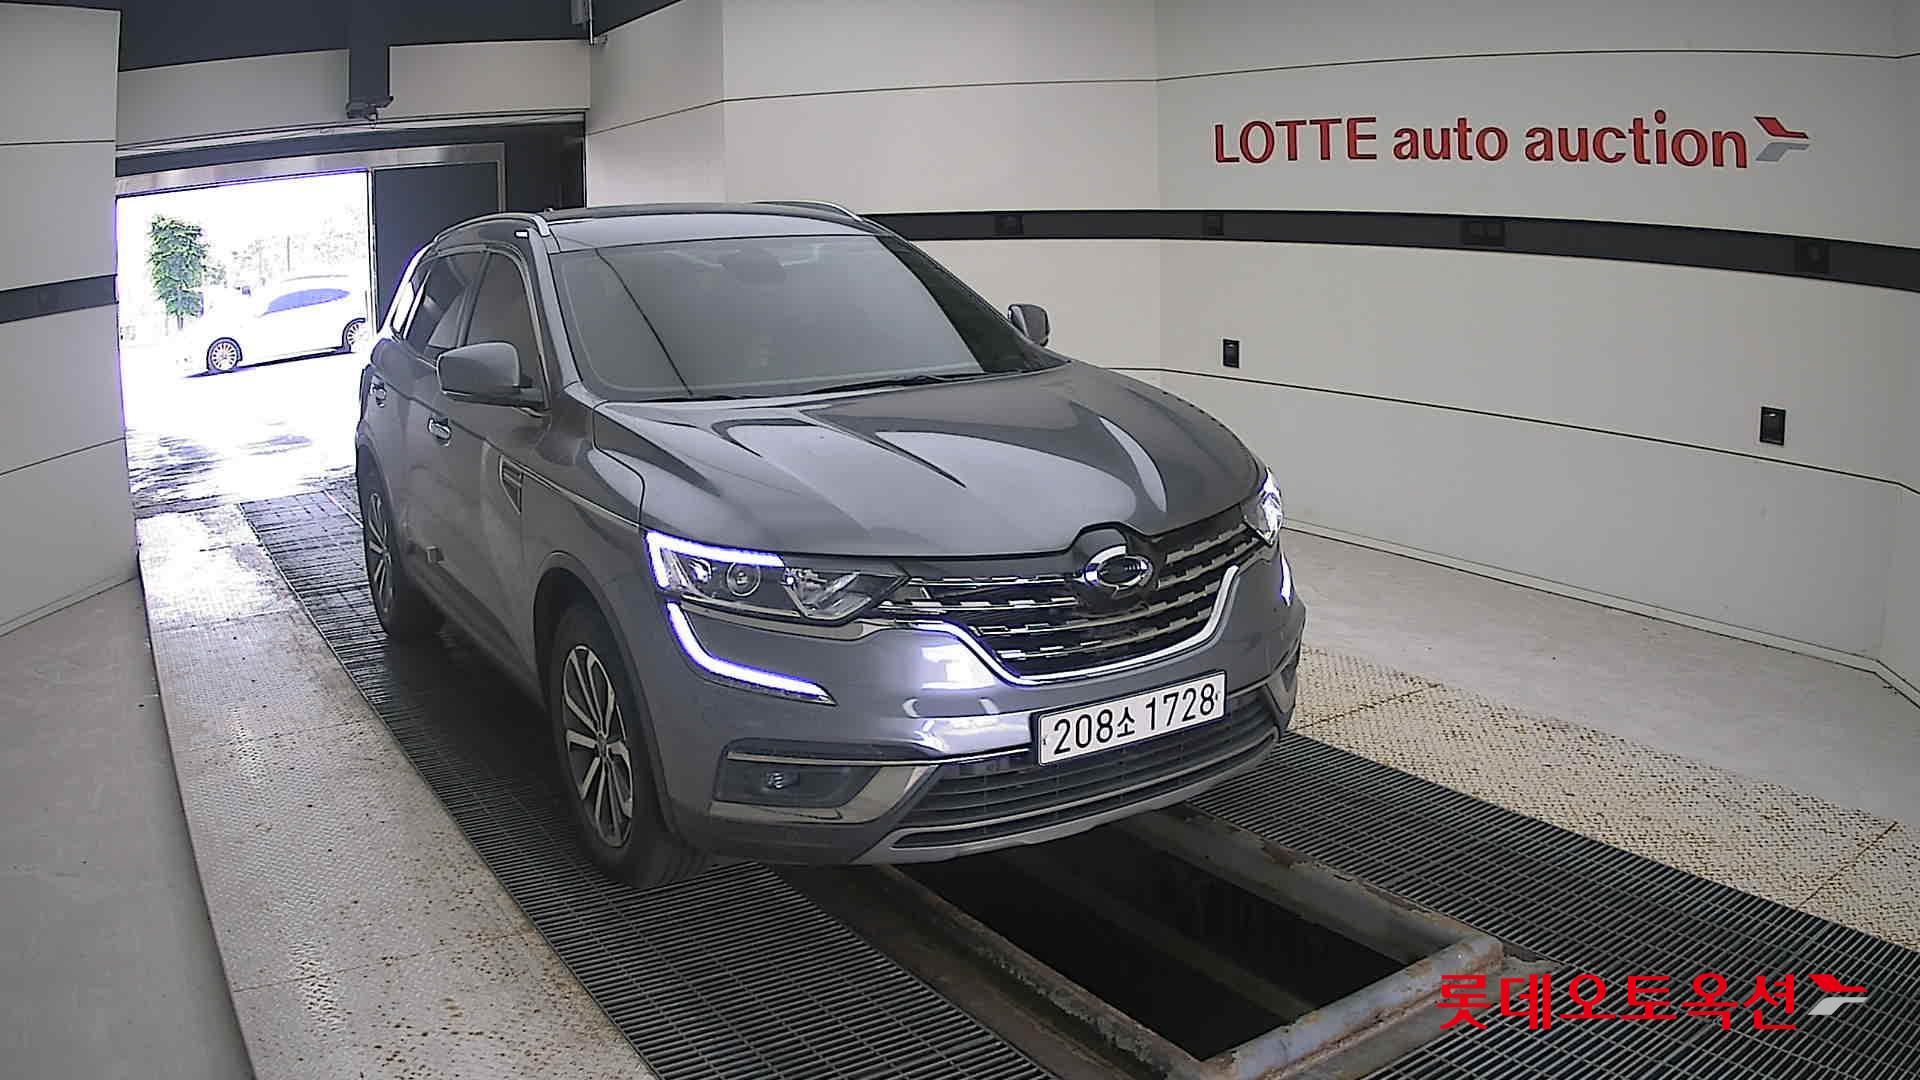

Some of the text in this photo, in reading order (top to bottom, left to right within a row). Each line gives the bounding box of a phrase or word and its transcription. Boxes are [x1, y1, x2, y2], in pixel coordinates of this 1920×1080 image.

[1215, 110, 1747, 168] LOTTE auto auction
[1053, 683, 1216, 756] 208소 1728
